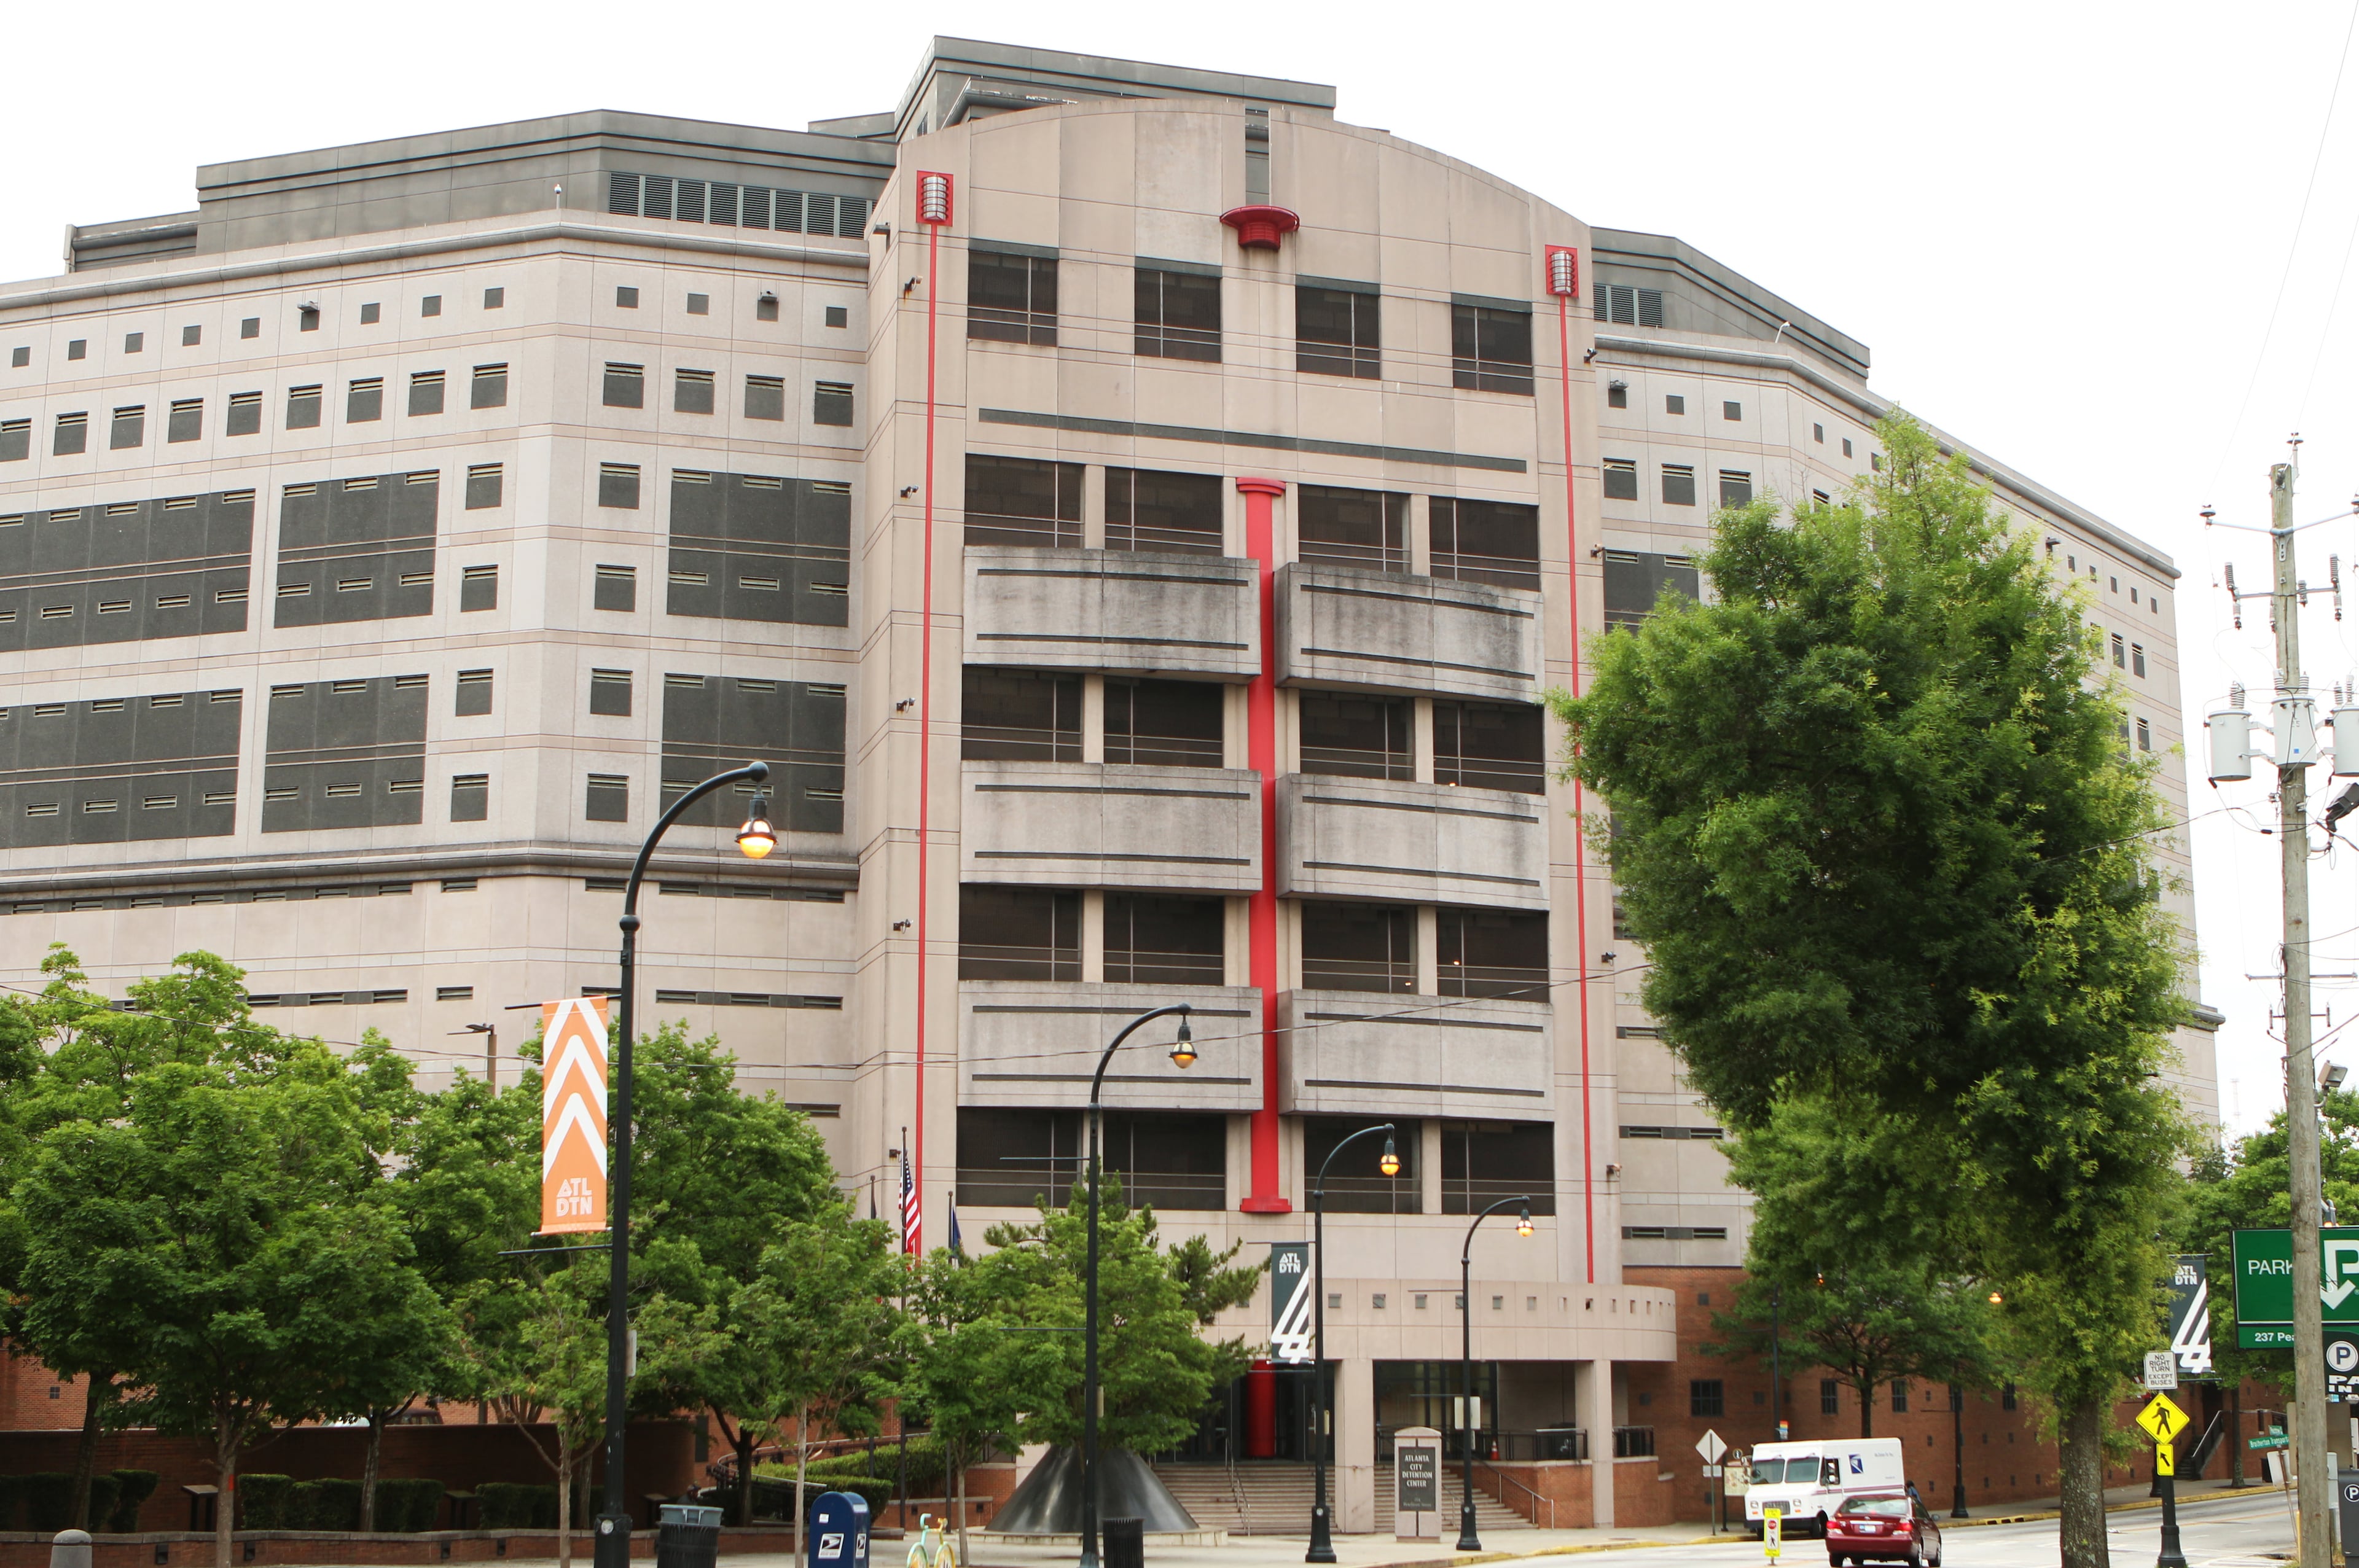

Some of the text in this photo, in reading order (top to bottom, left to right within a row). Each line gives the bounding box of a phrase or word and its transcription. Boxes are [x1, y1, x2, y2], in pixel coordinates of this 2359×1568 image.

[557, 1177, 592, 1198] ATL
[556, 1196, 593, 1217] DTN
[1279, 1253, 1301, 1263] ATL
[1279, 1263, 1301, 1274] DTN
[2175, 1275, 2197, 1285] DTN
[2255, 1332, 2274, 1342] 237
[2336, 1346, 2350, 1365] P
[2328, 1384, 2352, 1393] IN
[1402, 1470, 1433, 1479] DETENTION
[2349, 1487, 2359, 1499] P
